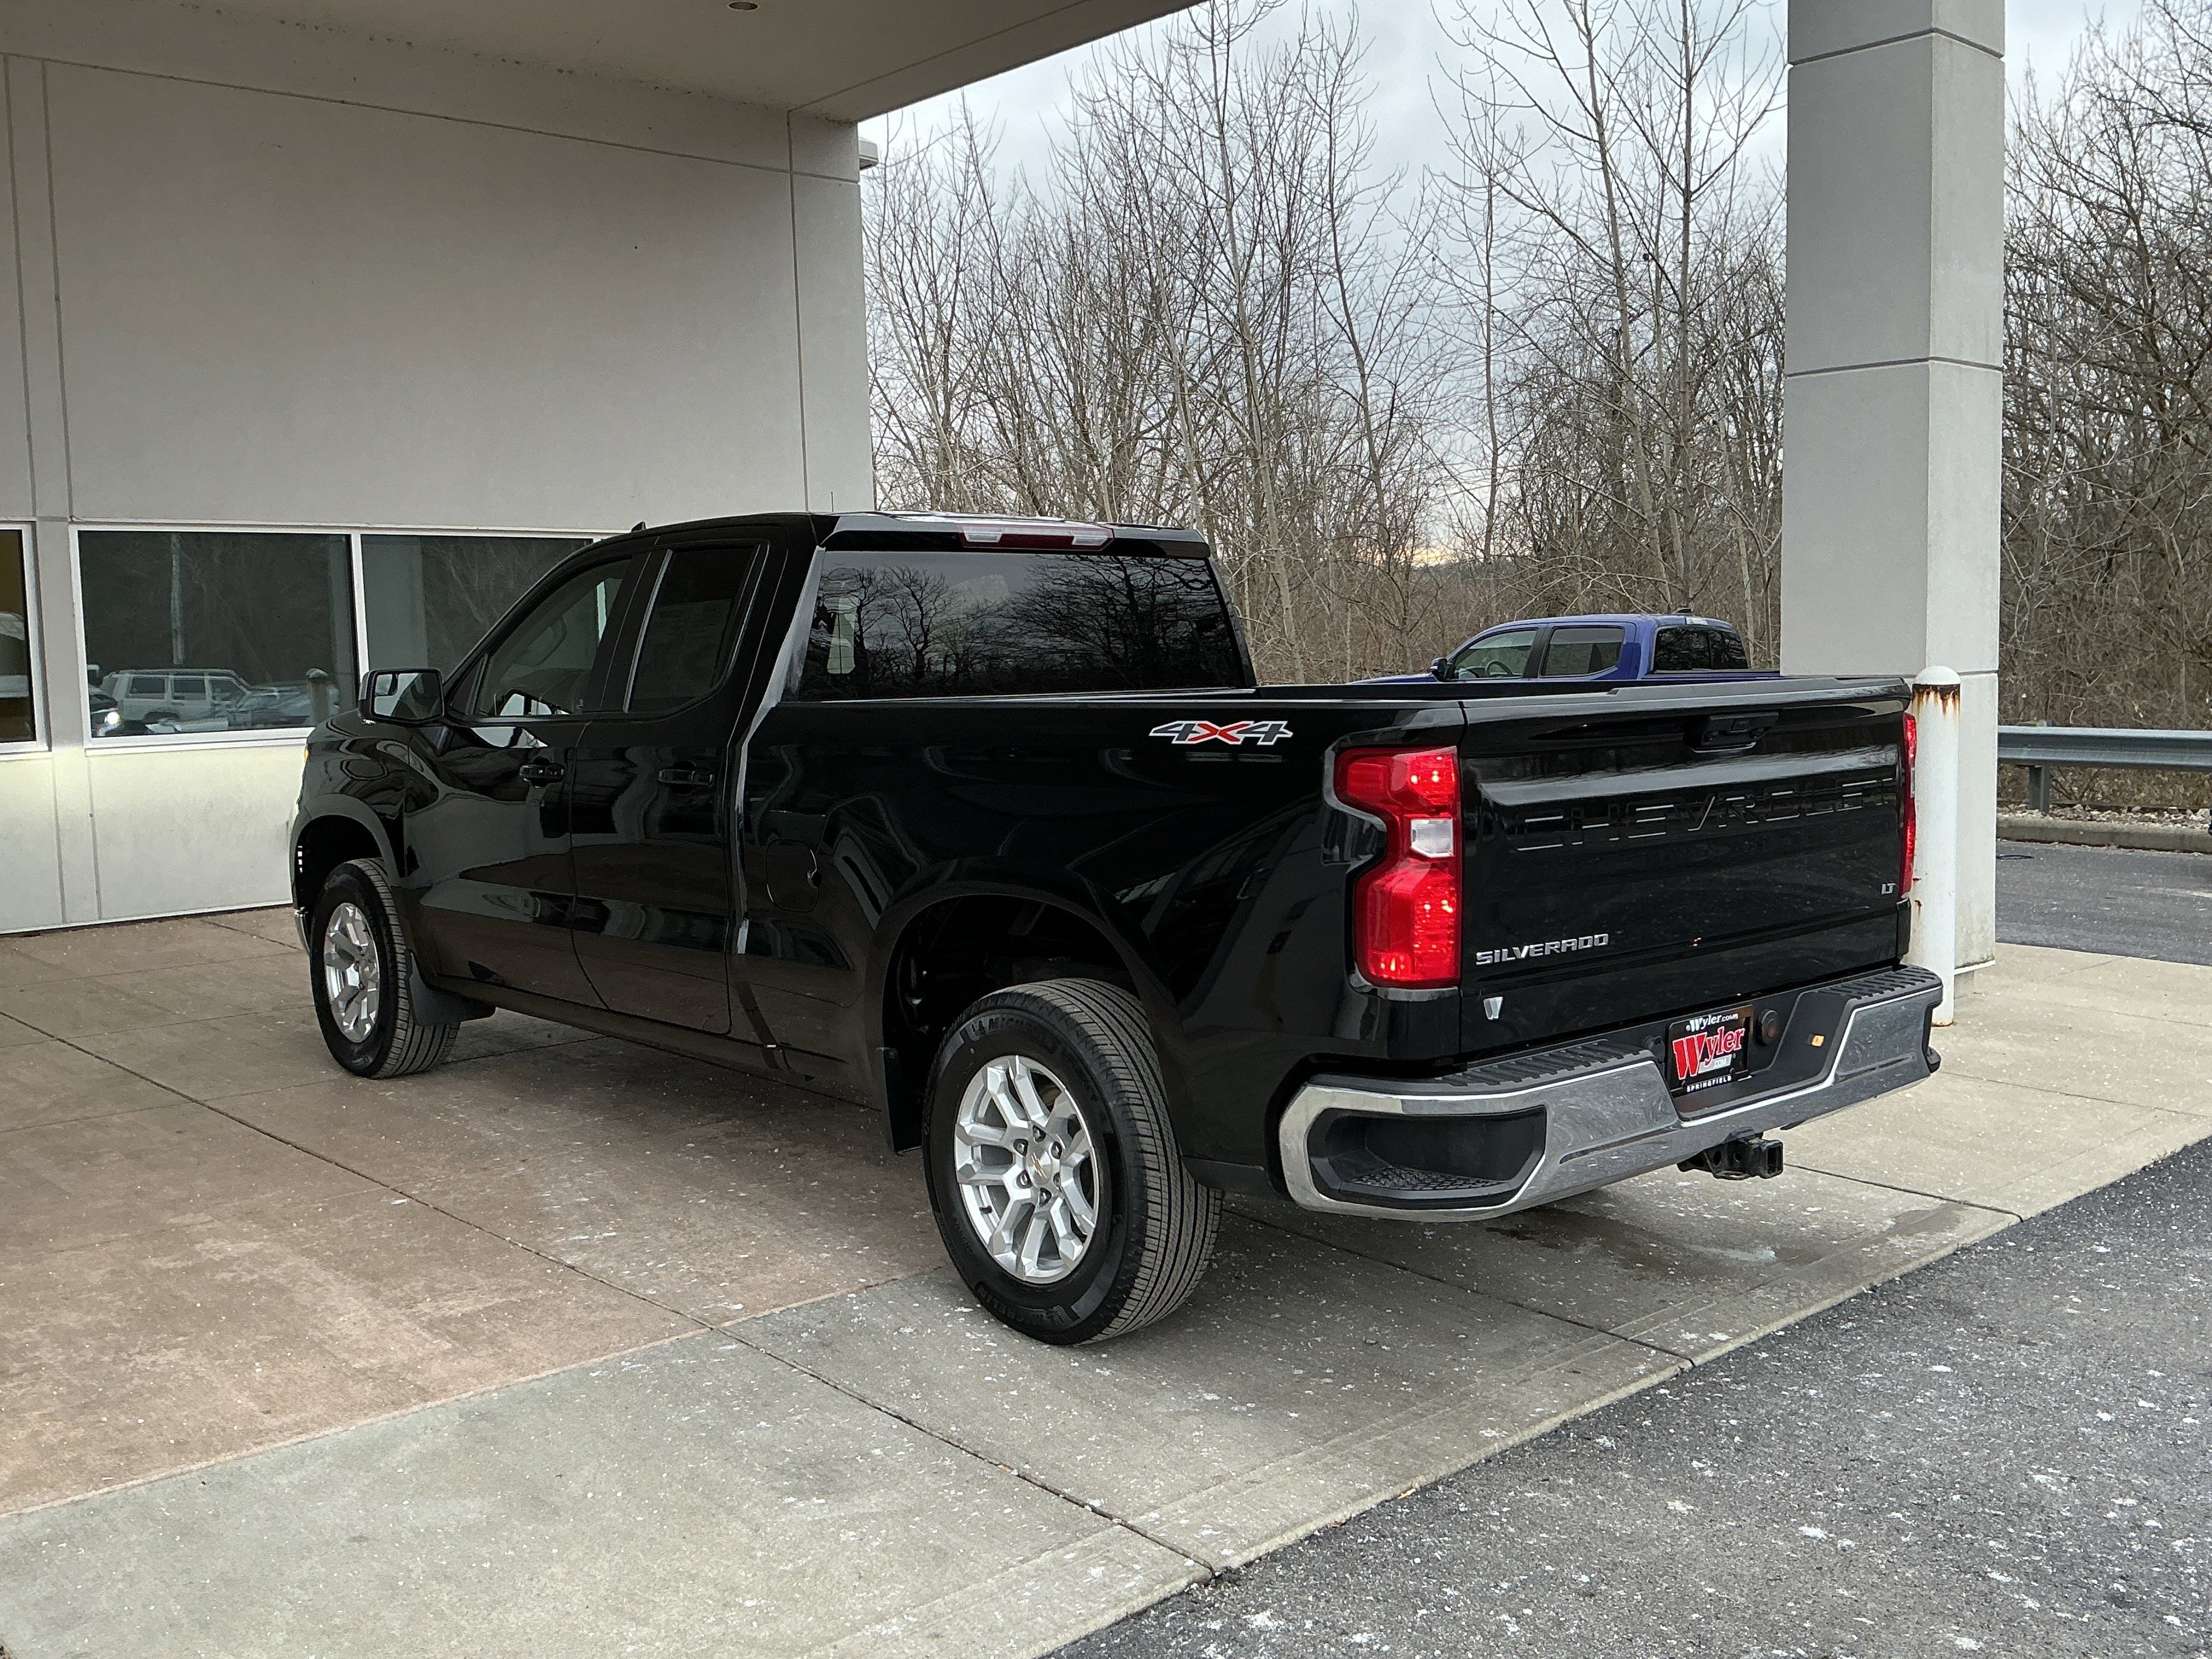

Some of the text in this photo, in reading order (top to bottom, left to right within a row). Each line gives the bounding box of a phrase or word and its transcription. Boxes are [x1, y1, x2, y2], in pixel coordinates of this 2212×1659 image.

[1881, 883, 1896, 895] LT
[1476, 933, 1609, 965] SILVERADO
[1673, 1026, 1745, 1080] Wyler
[1686, 1075, 1732, 1092] SPRINGFIELD
